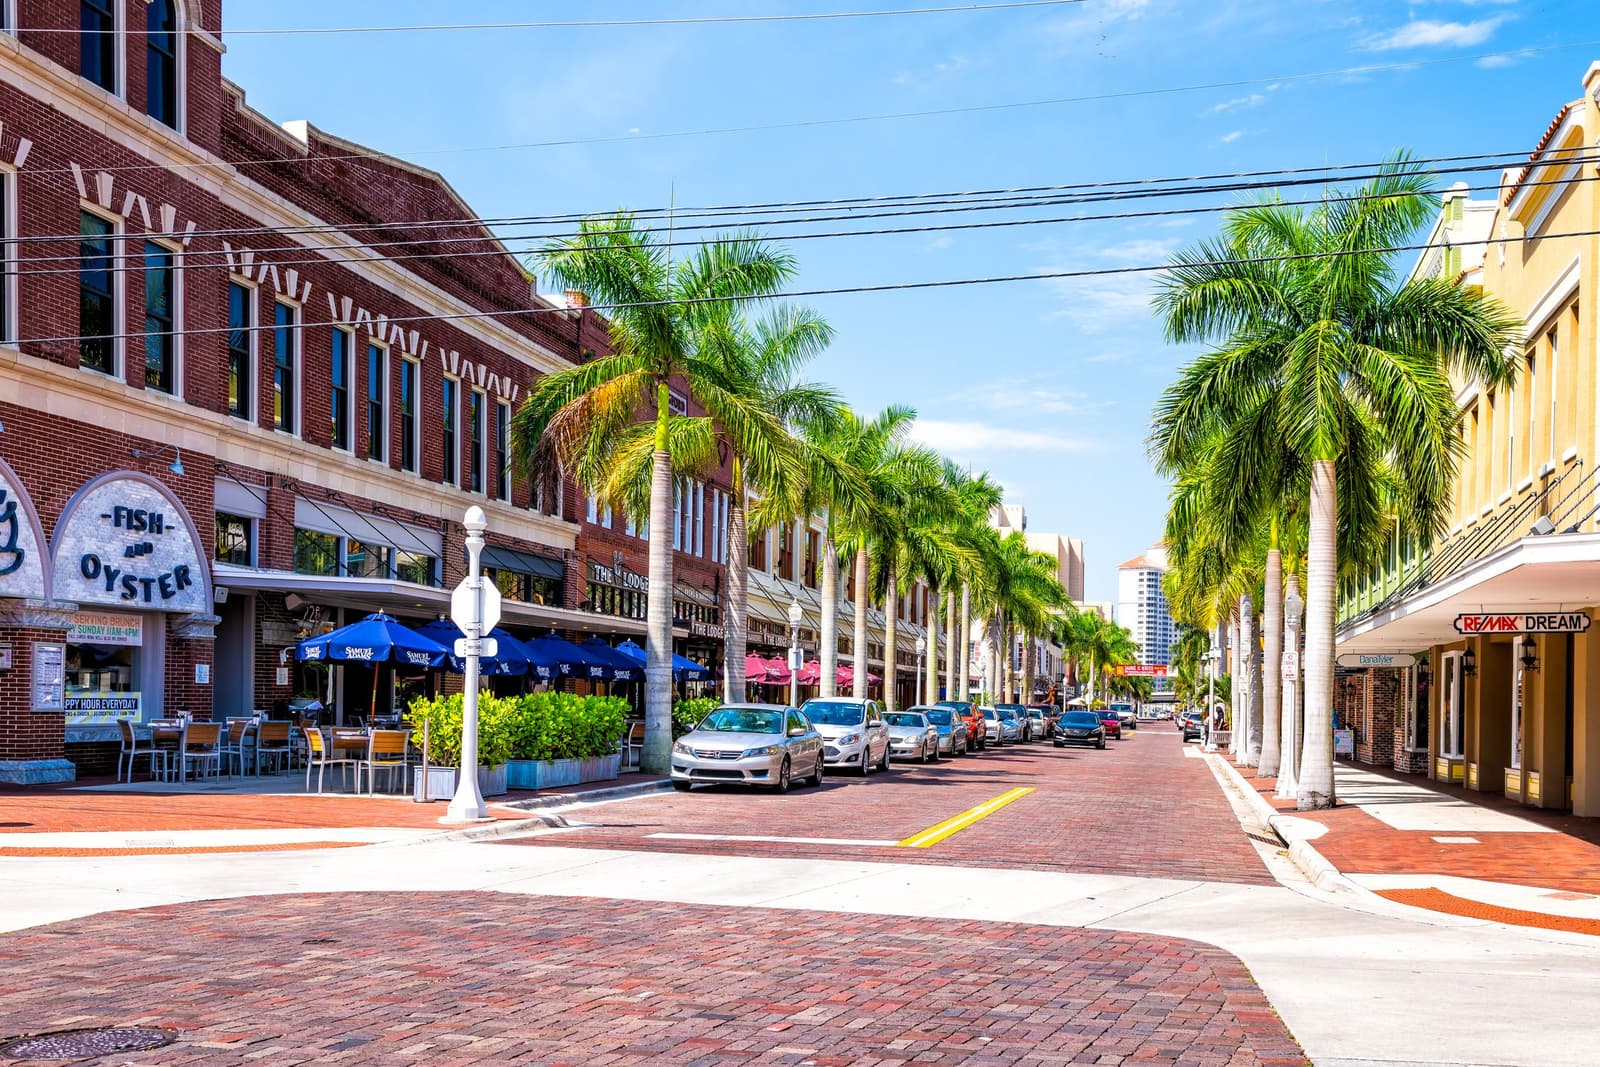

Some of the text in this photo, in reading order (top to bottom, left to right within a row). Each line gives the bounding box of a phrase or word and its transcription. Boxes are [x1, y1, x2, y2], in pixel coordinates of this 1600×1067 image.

[124, 542, 153, 558] AND
[81, 554, 192, 602] OYSTER
[594, 565, 612, 583] THE
[74, 614, 108, 626] SERVING
[110, 615, 140, 628] BRUNCH
[1525, 615, 1581, 630] DREAM
[78, 624, 105, 635] SUNDAY
[695, 623, 706, 636] THE
[345, 646, 374, 656] SAMUEL
[65, 698, 137, 710] PPY HOUR EVERYDAY
